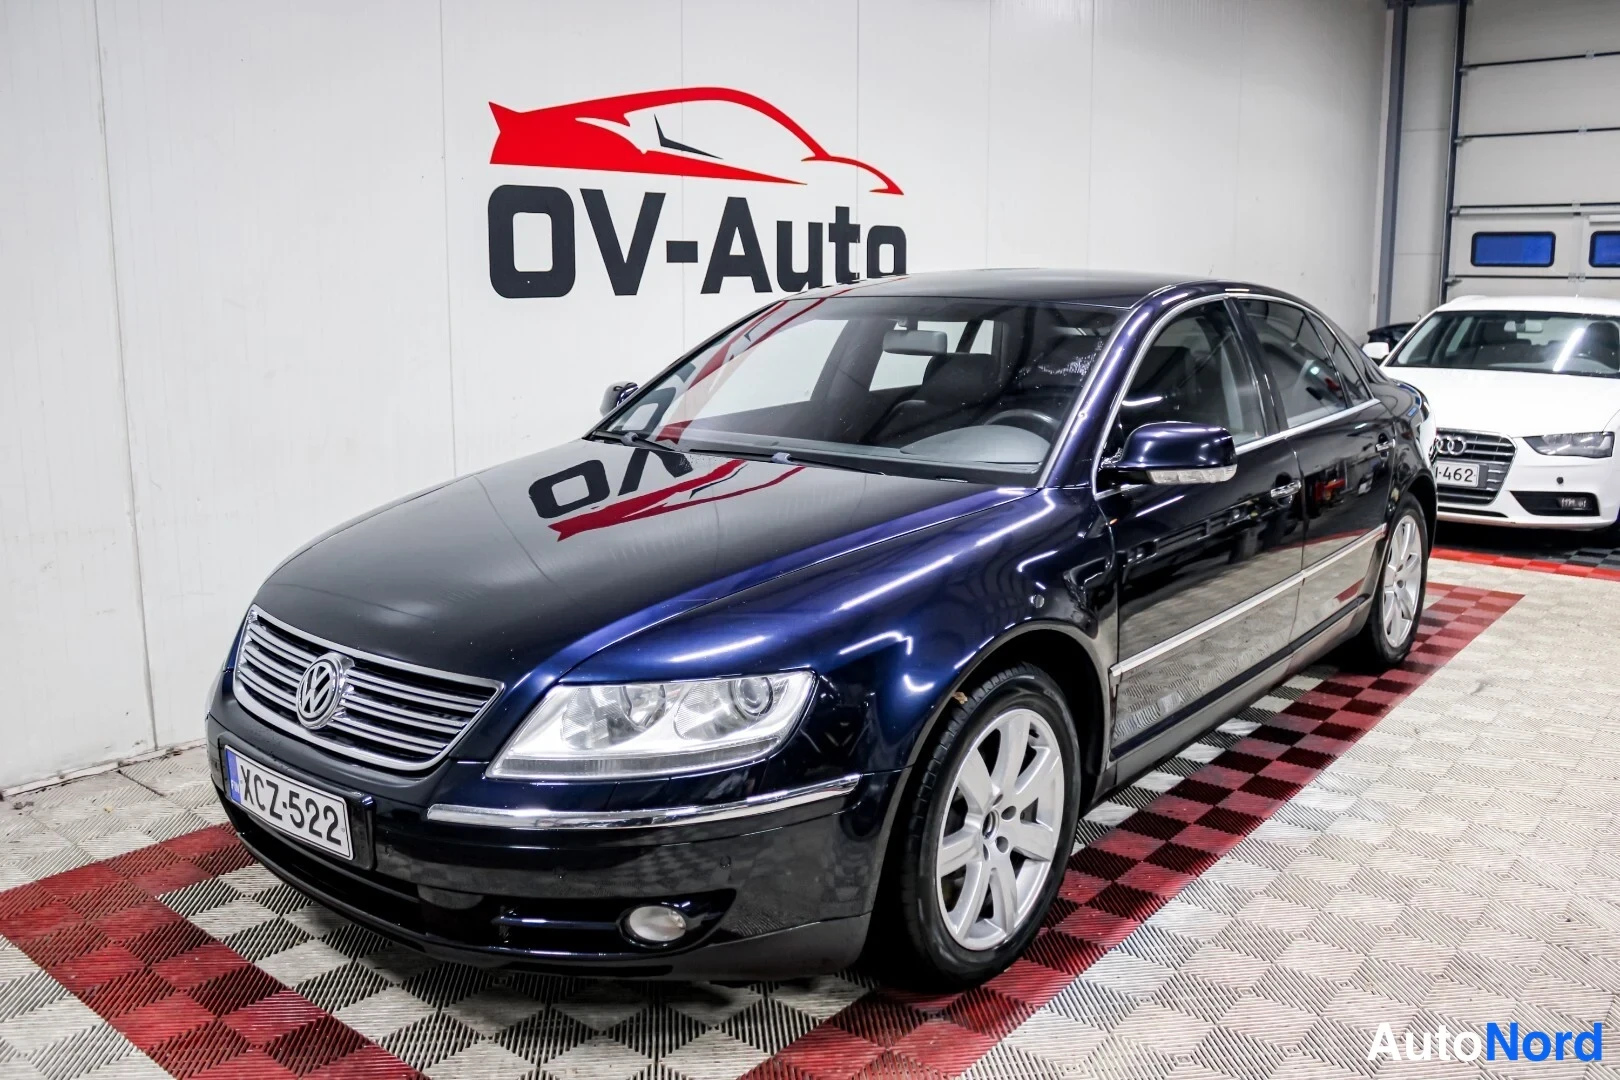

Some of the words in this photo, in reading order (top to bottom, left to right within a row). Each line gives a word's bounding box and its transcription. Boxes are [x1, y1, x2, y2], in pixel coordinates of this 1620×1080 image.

[488, 184, 907, 298] OV-Auto
[1435, 466, 1474, 483] -462
[240, 764, 342, 846] XCZ-522
